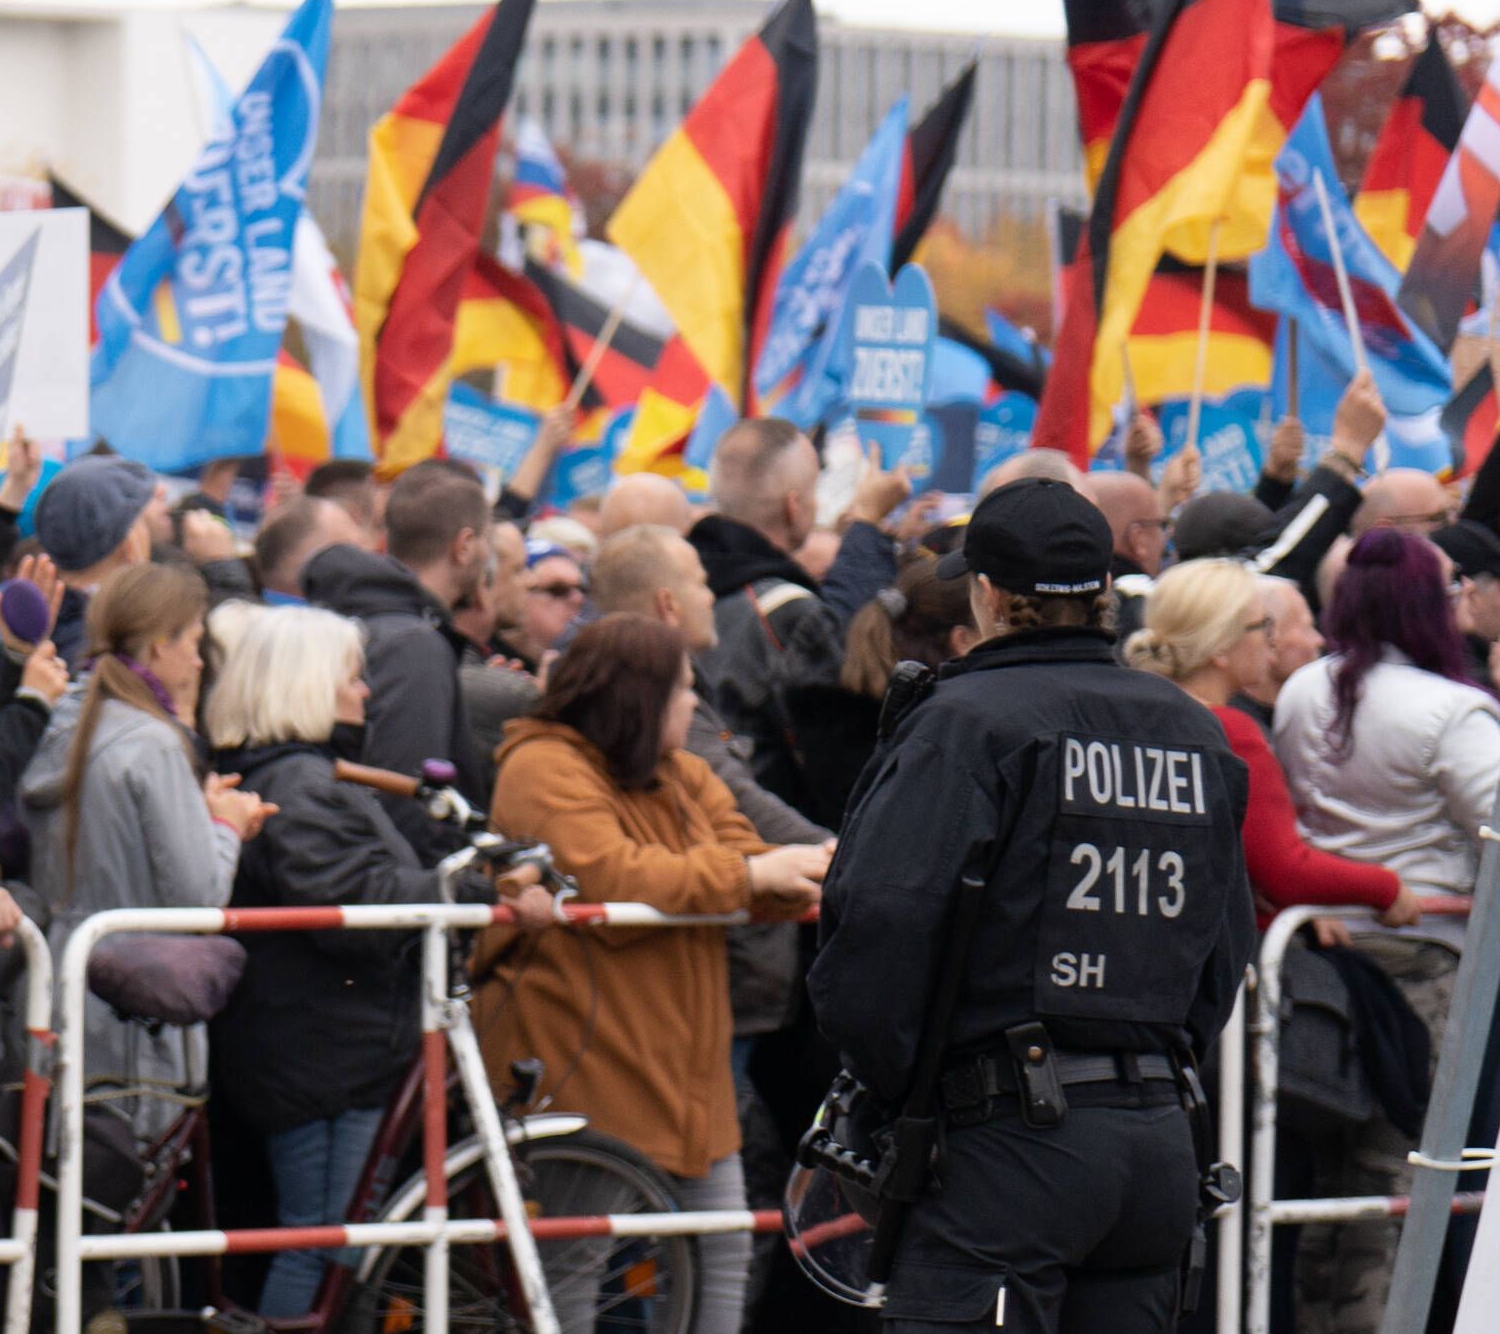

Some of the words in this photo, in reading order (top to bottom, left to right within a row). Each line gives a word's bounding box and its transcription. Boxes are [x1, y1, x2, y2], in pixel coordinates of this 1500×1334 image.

[1064, 738, 1206, 814] POLIZEI
[1066, 841, 1186, 918] 2113
[1050, 952, 1106, 988] SH
